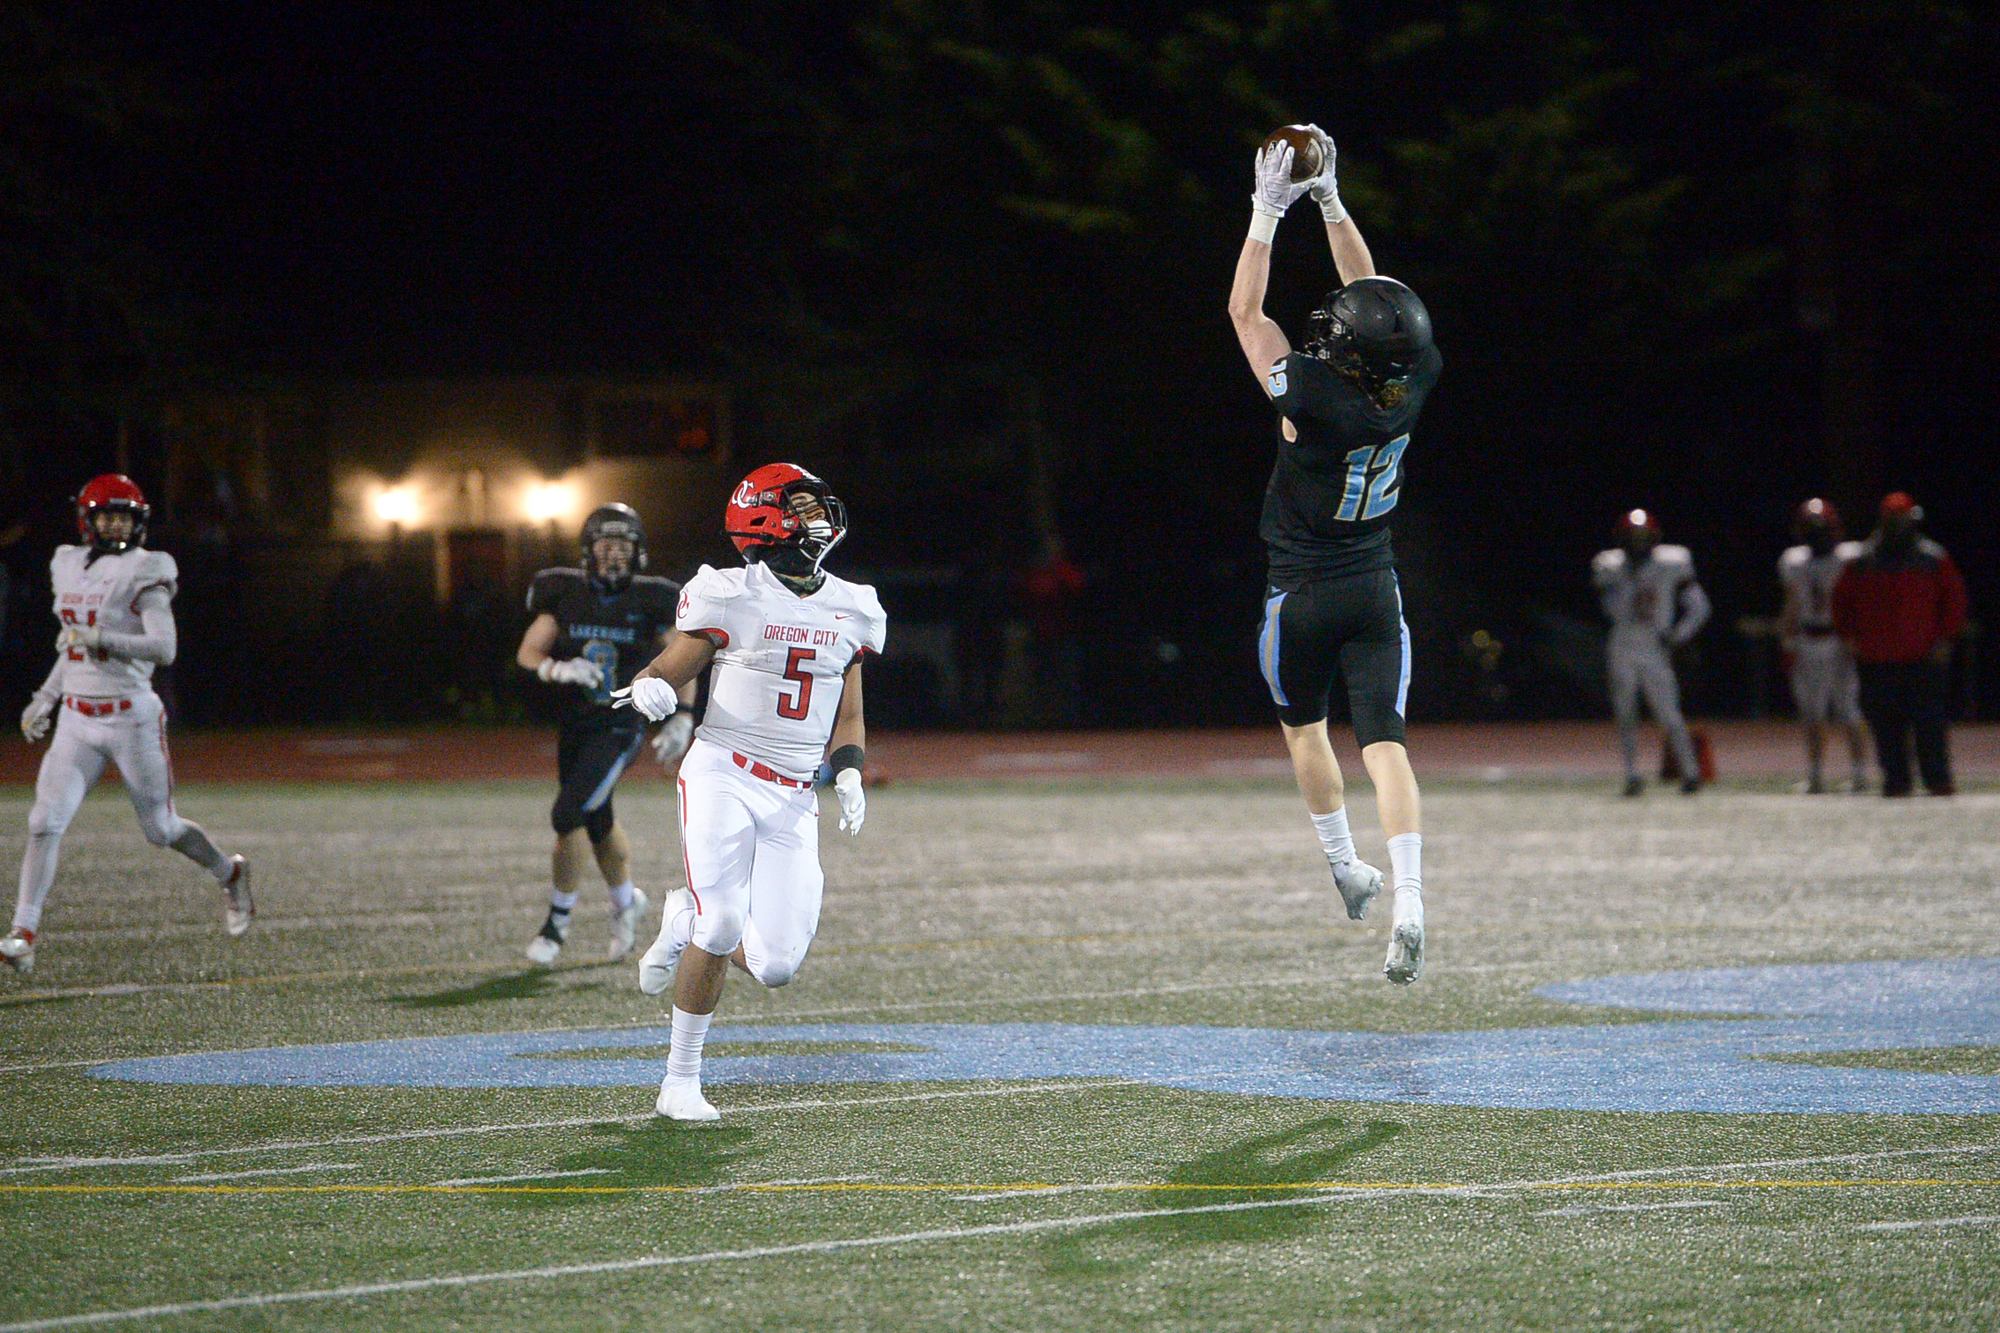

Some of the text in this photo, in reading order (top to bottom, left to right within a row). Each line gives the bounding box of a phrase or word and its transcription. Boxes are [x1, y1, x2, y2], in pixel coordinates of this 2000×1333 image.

[1333, 432, 1411, 521] 12
[763, 624, 839, 647] OREGON CITY
[776, 646, 816, 721] 5
